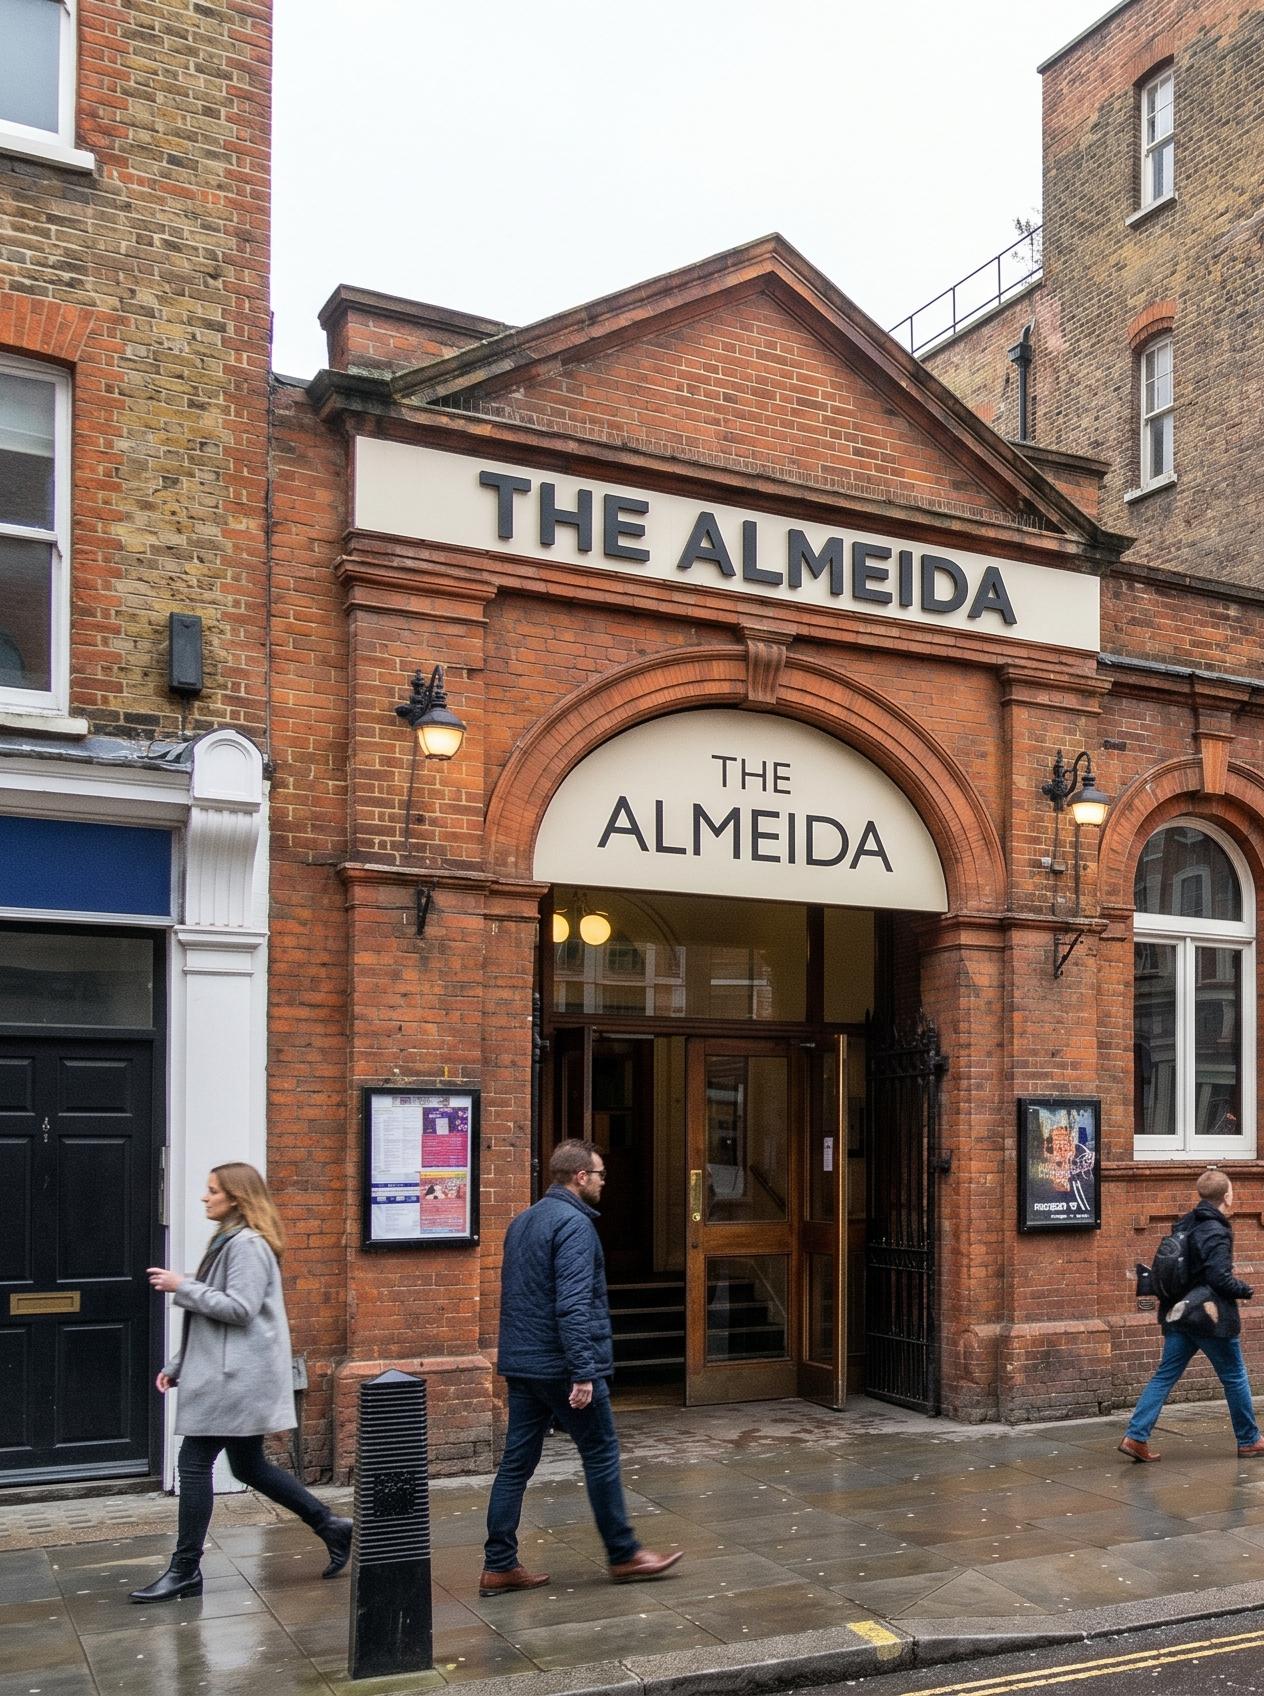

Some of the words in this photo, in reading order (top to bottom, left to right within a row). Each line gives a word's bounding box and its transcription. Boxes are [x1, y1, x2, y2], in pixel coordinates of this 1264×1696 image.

[479, 471, 651, 565] THE
[676, 511, 1018, 627] ALMEIDA
[711, 754, 792, 796] THE
[596, 795, 895, 873] ALMEIDA
